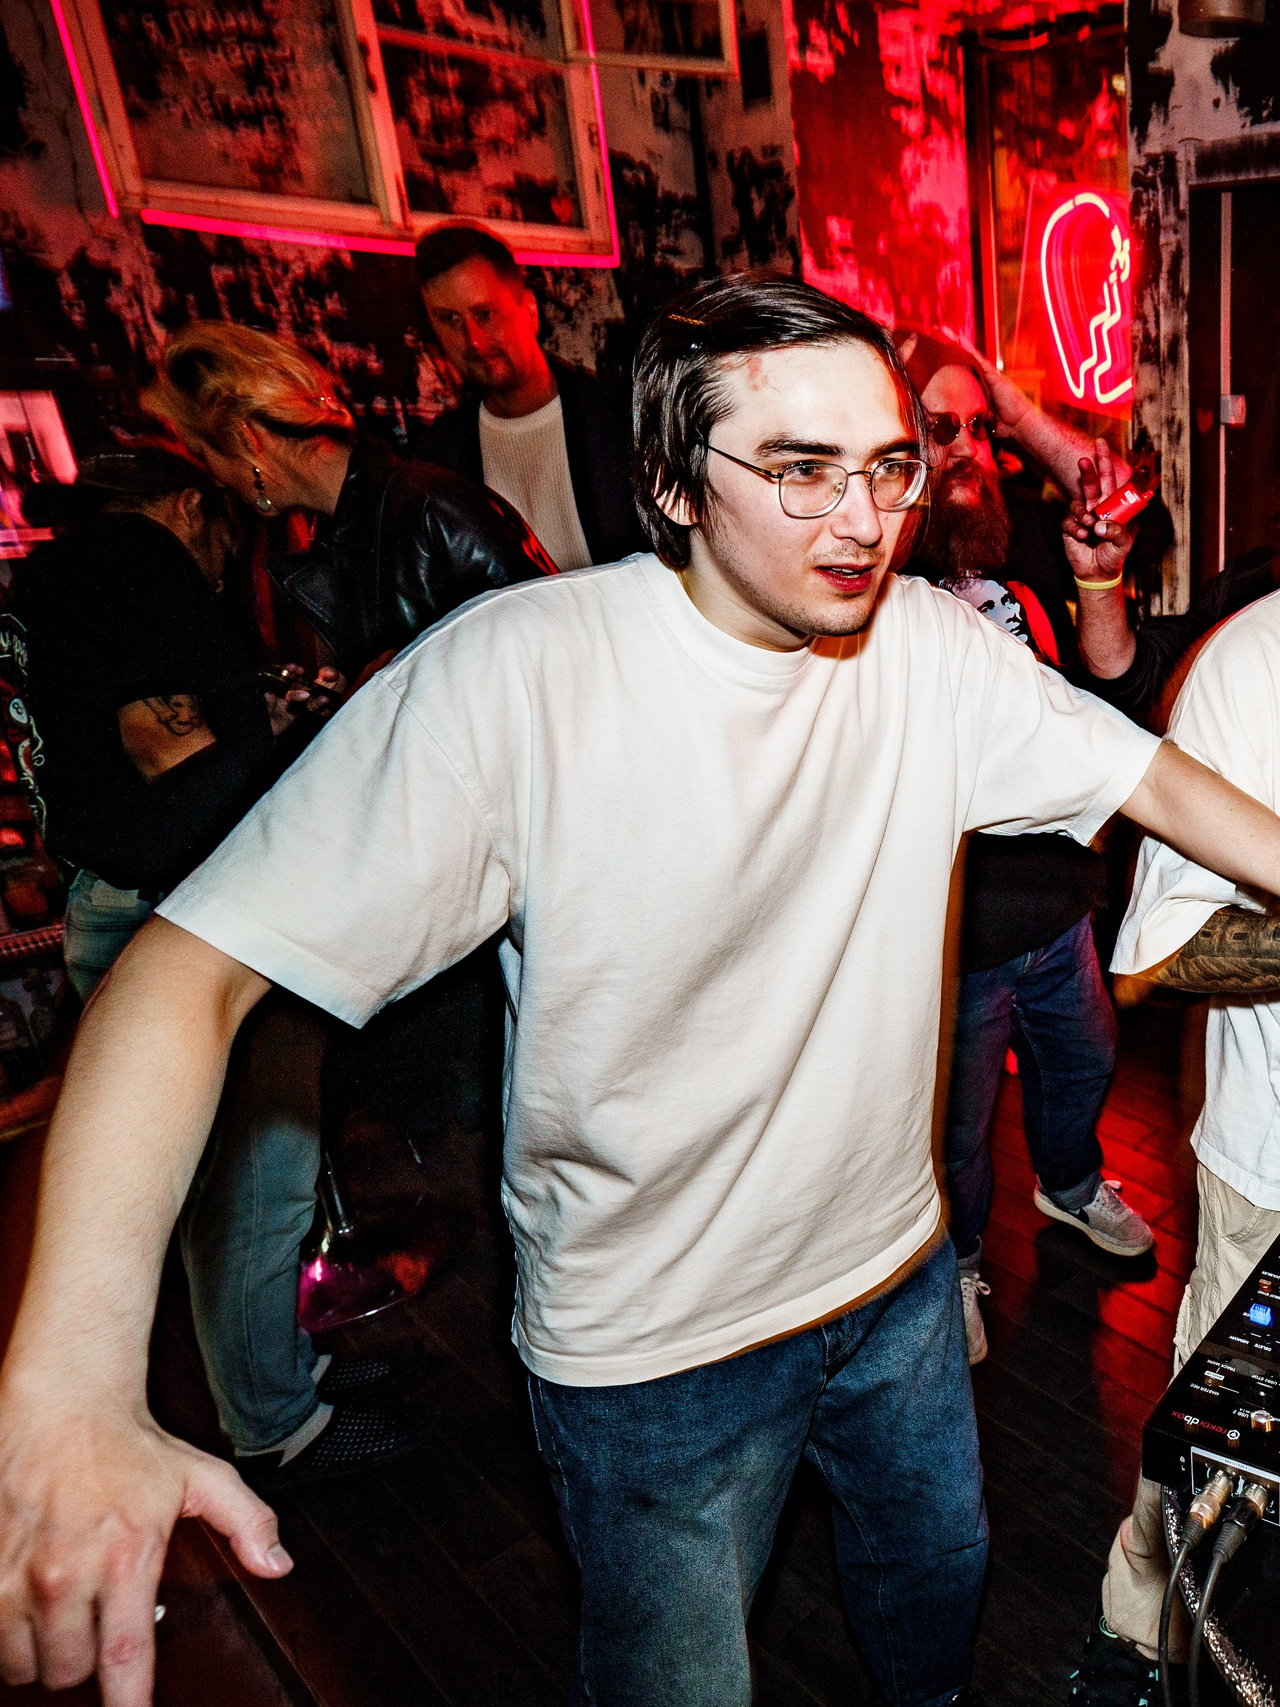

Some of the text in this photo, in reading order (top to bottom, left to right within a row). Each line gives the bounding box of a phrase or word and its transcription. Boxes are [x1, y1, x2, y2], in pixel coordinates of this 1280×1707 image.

[1200, 1386, 1220, 1396] MASTER
[1170, 1409, 1227, 1434] rekordbox
[1224, 1458, 1245, 1469] MASTER
